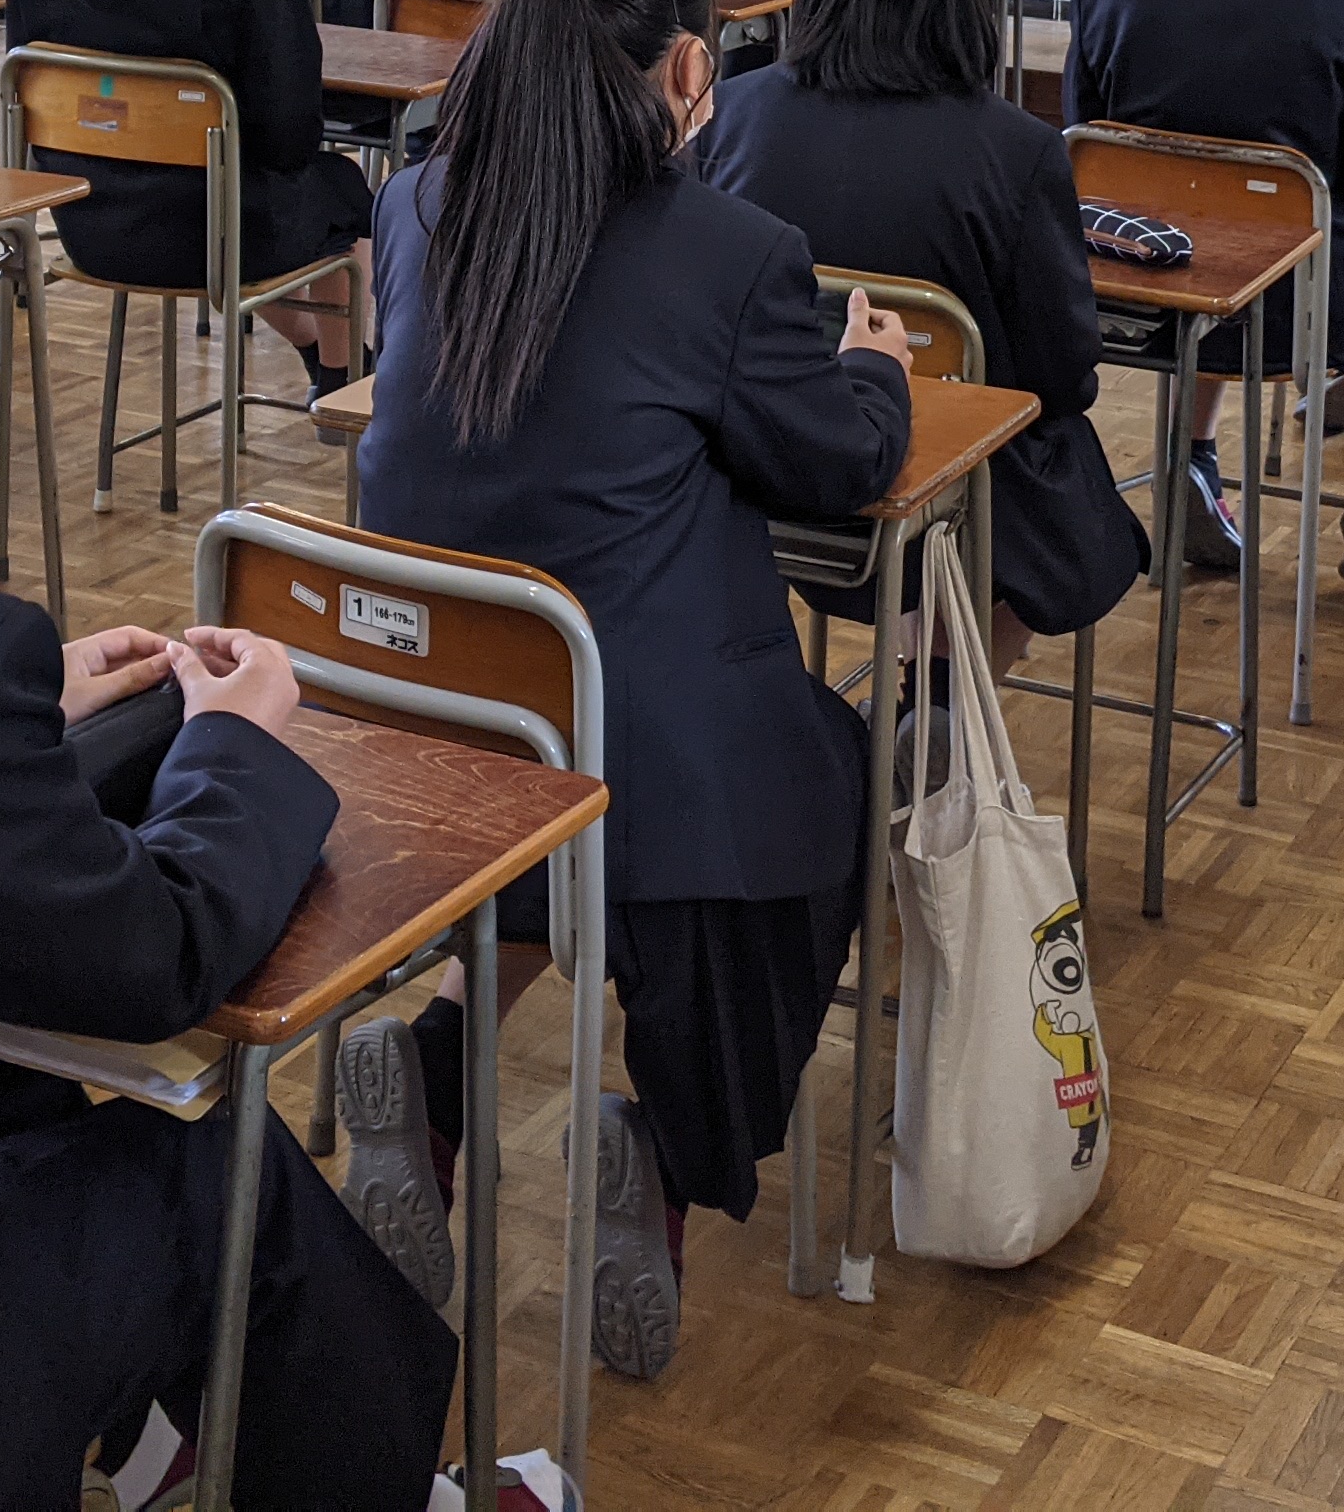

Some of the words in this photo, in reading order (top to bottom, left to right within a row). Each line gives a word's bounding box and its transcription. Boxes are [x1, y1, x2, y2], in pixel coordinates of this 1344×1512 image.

[353, 597, 362, 617] 1
[386, 634, 419, 654] ネコス
